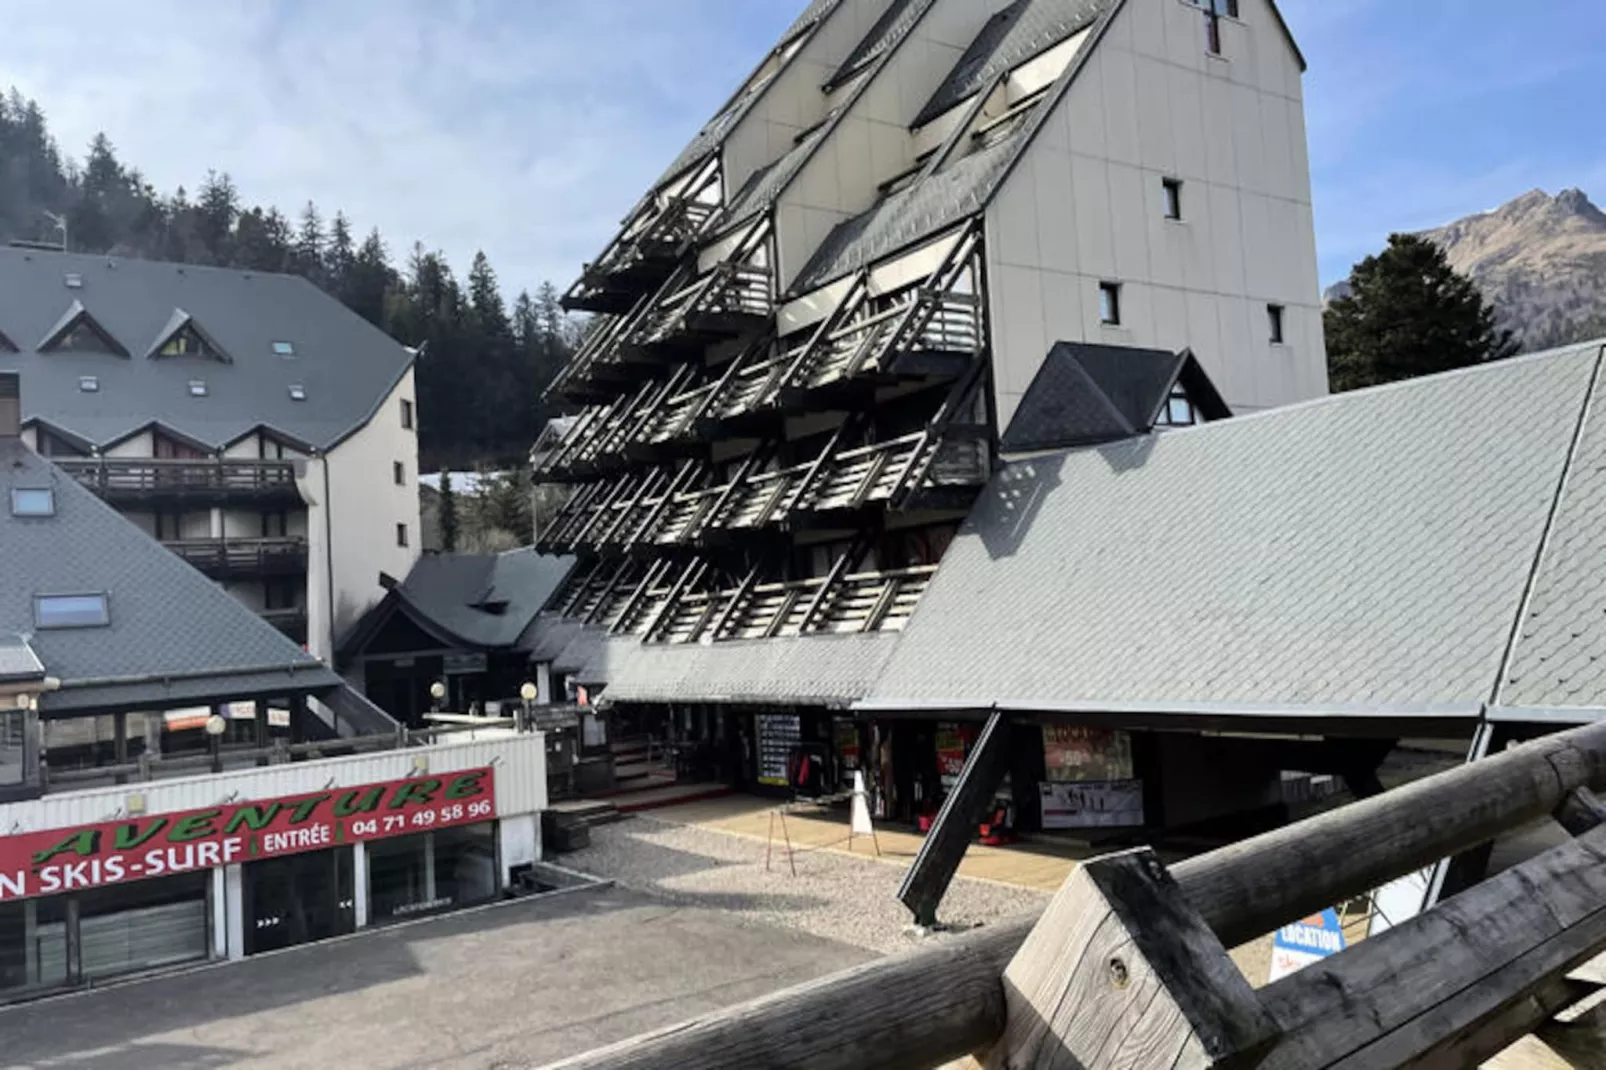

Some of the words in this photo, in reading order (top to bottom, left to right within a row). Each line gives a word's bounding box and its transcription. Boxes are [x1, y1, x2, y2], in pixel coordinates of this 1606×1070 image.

[32, 771, 487, 864] AVENTURE
[40, 837, 242, 893] SKIS-SURF
[263, 822, 330, 852] ENTRÉE
[352, 820, 377, 835] 04
[382, 814, 405, 832] 71
[412, 809, 435, 826] 49
[441, 804, 463, 822] 58
[468, 799, 491, 816] 96
[1281, 922, 1342, 953] LOCATION
